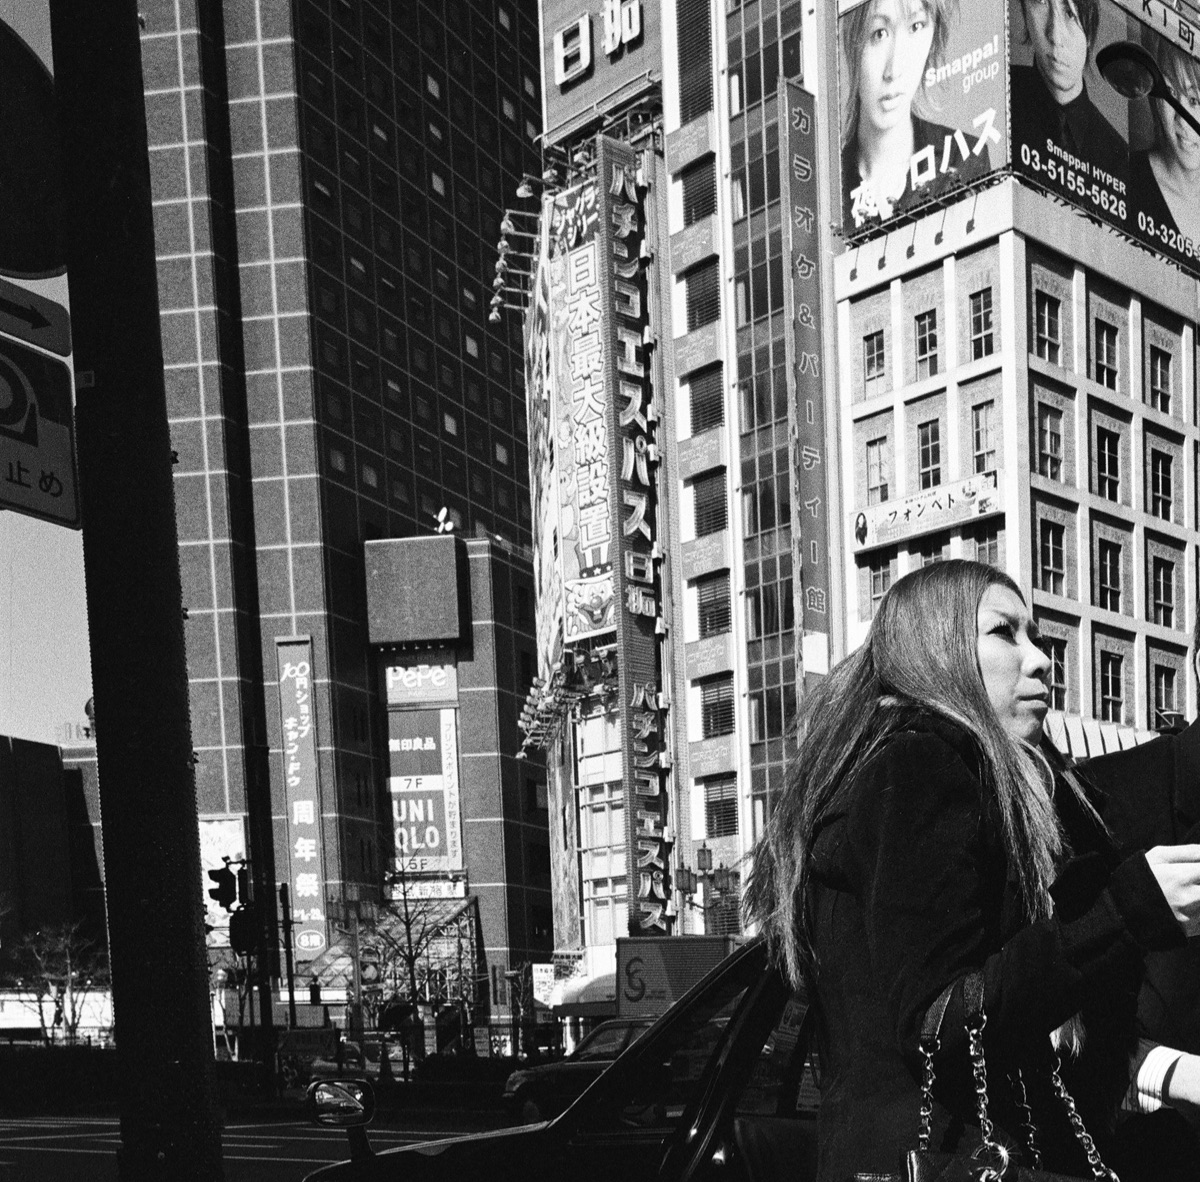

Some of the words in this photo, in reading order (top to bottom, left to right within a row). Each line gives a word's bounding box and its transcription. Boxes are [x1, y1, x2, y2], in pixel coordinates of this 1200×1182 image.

[962, 61, 999, 94] group
[1045, 138, 1090, 174] Smappa!
[1092, 164, 1127, 196] HYPER
[1020, 143, 1128, 221] 03-5155-5626
[388, 737, 436, 752] 無印良品
[404, 778, 423, 790] 7F
[392, 799, 434, 823] UNI
[394, 826, 440, 853] QLO
[408, 858, 428, 871] 5F
